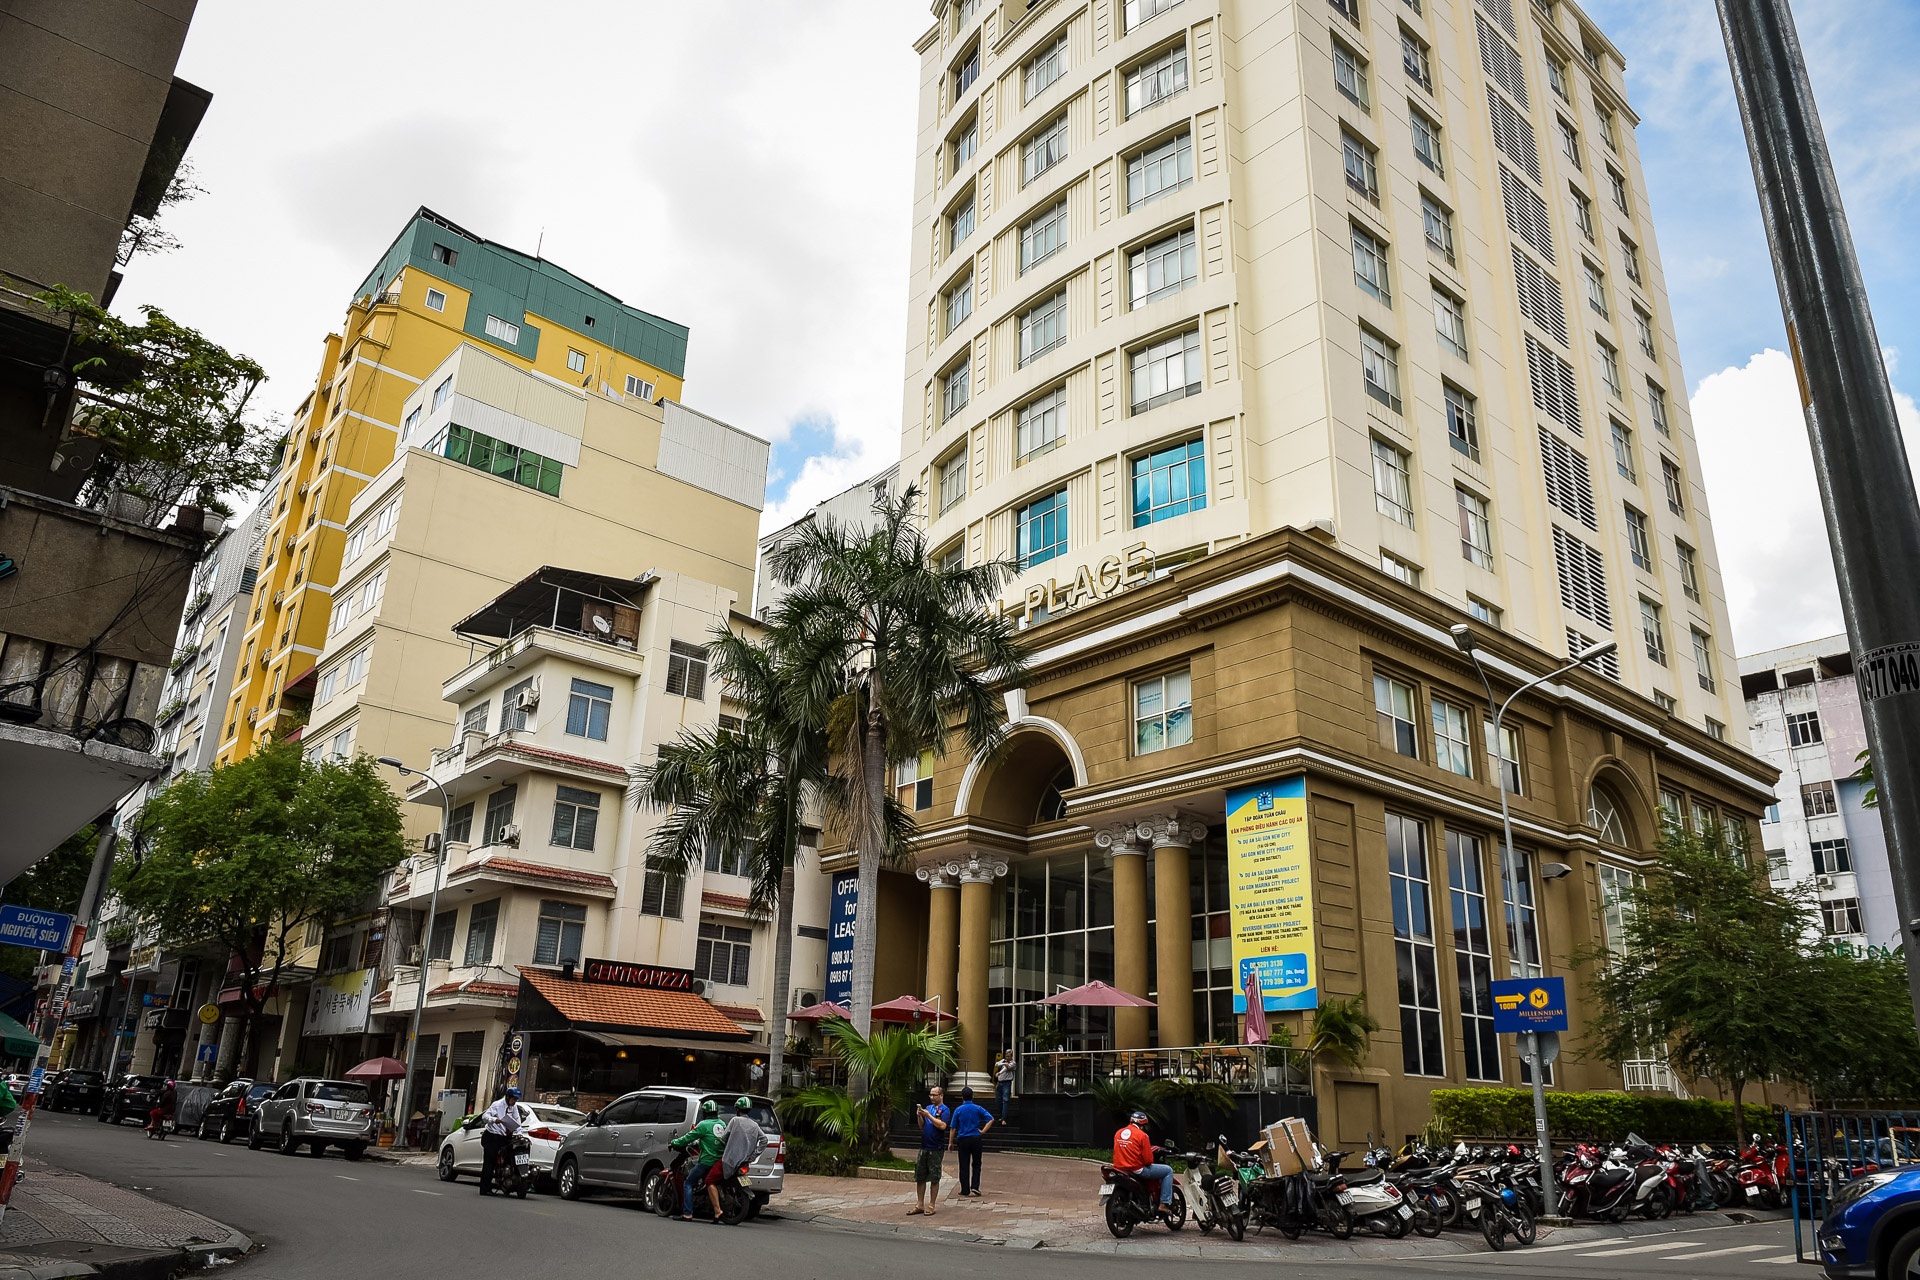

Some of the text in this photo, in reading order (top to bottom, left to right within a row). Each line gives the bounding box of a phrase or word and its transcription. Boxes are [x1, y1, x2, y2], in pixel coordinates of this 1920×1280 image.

[1024, 541, 1147, 624] PLACE
[845, 900, 857, 916] for
[17, 912, 55, 926] ĐƯỜNG
[0, 924, 60, 942] NGUYỄN SIÊU
[1534, 993, 1544, 1004] M
